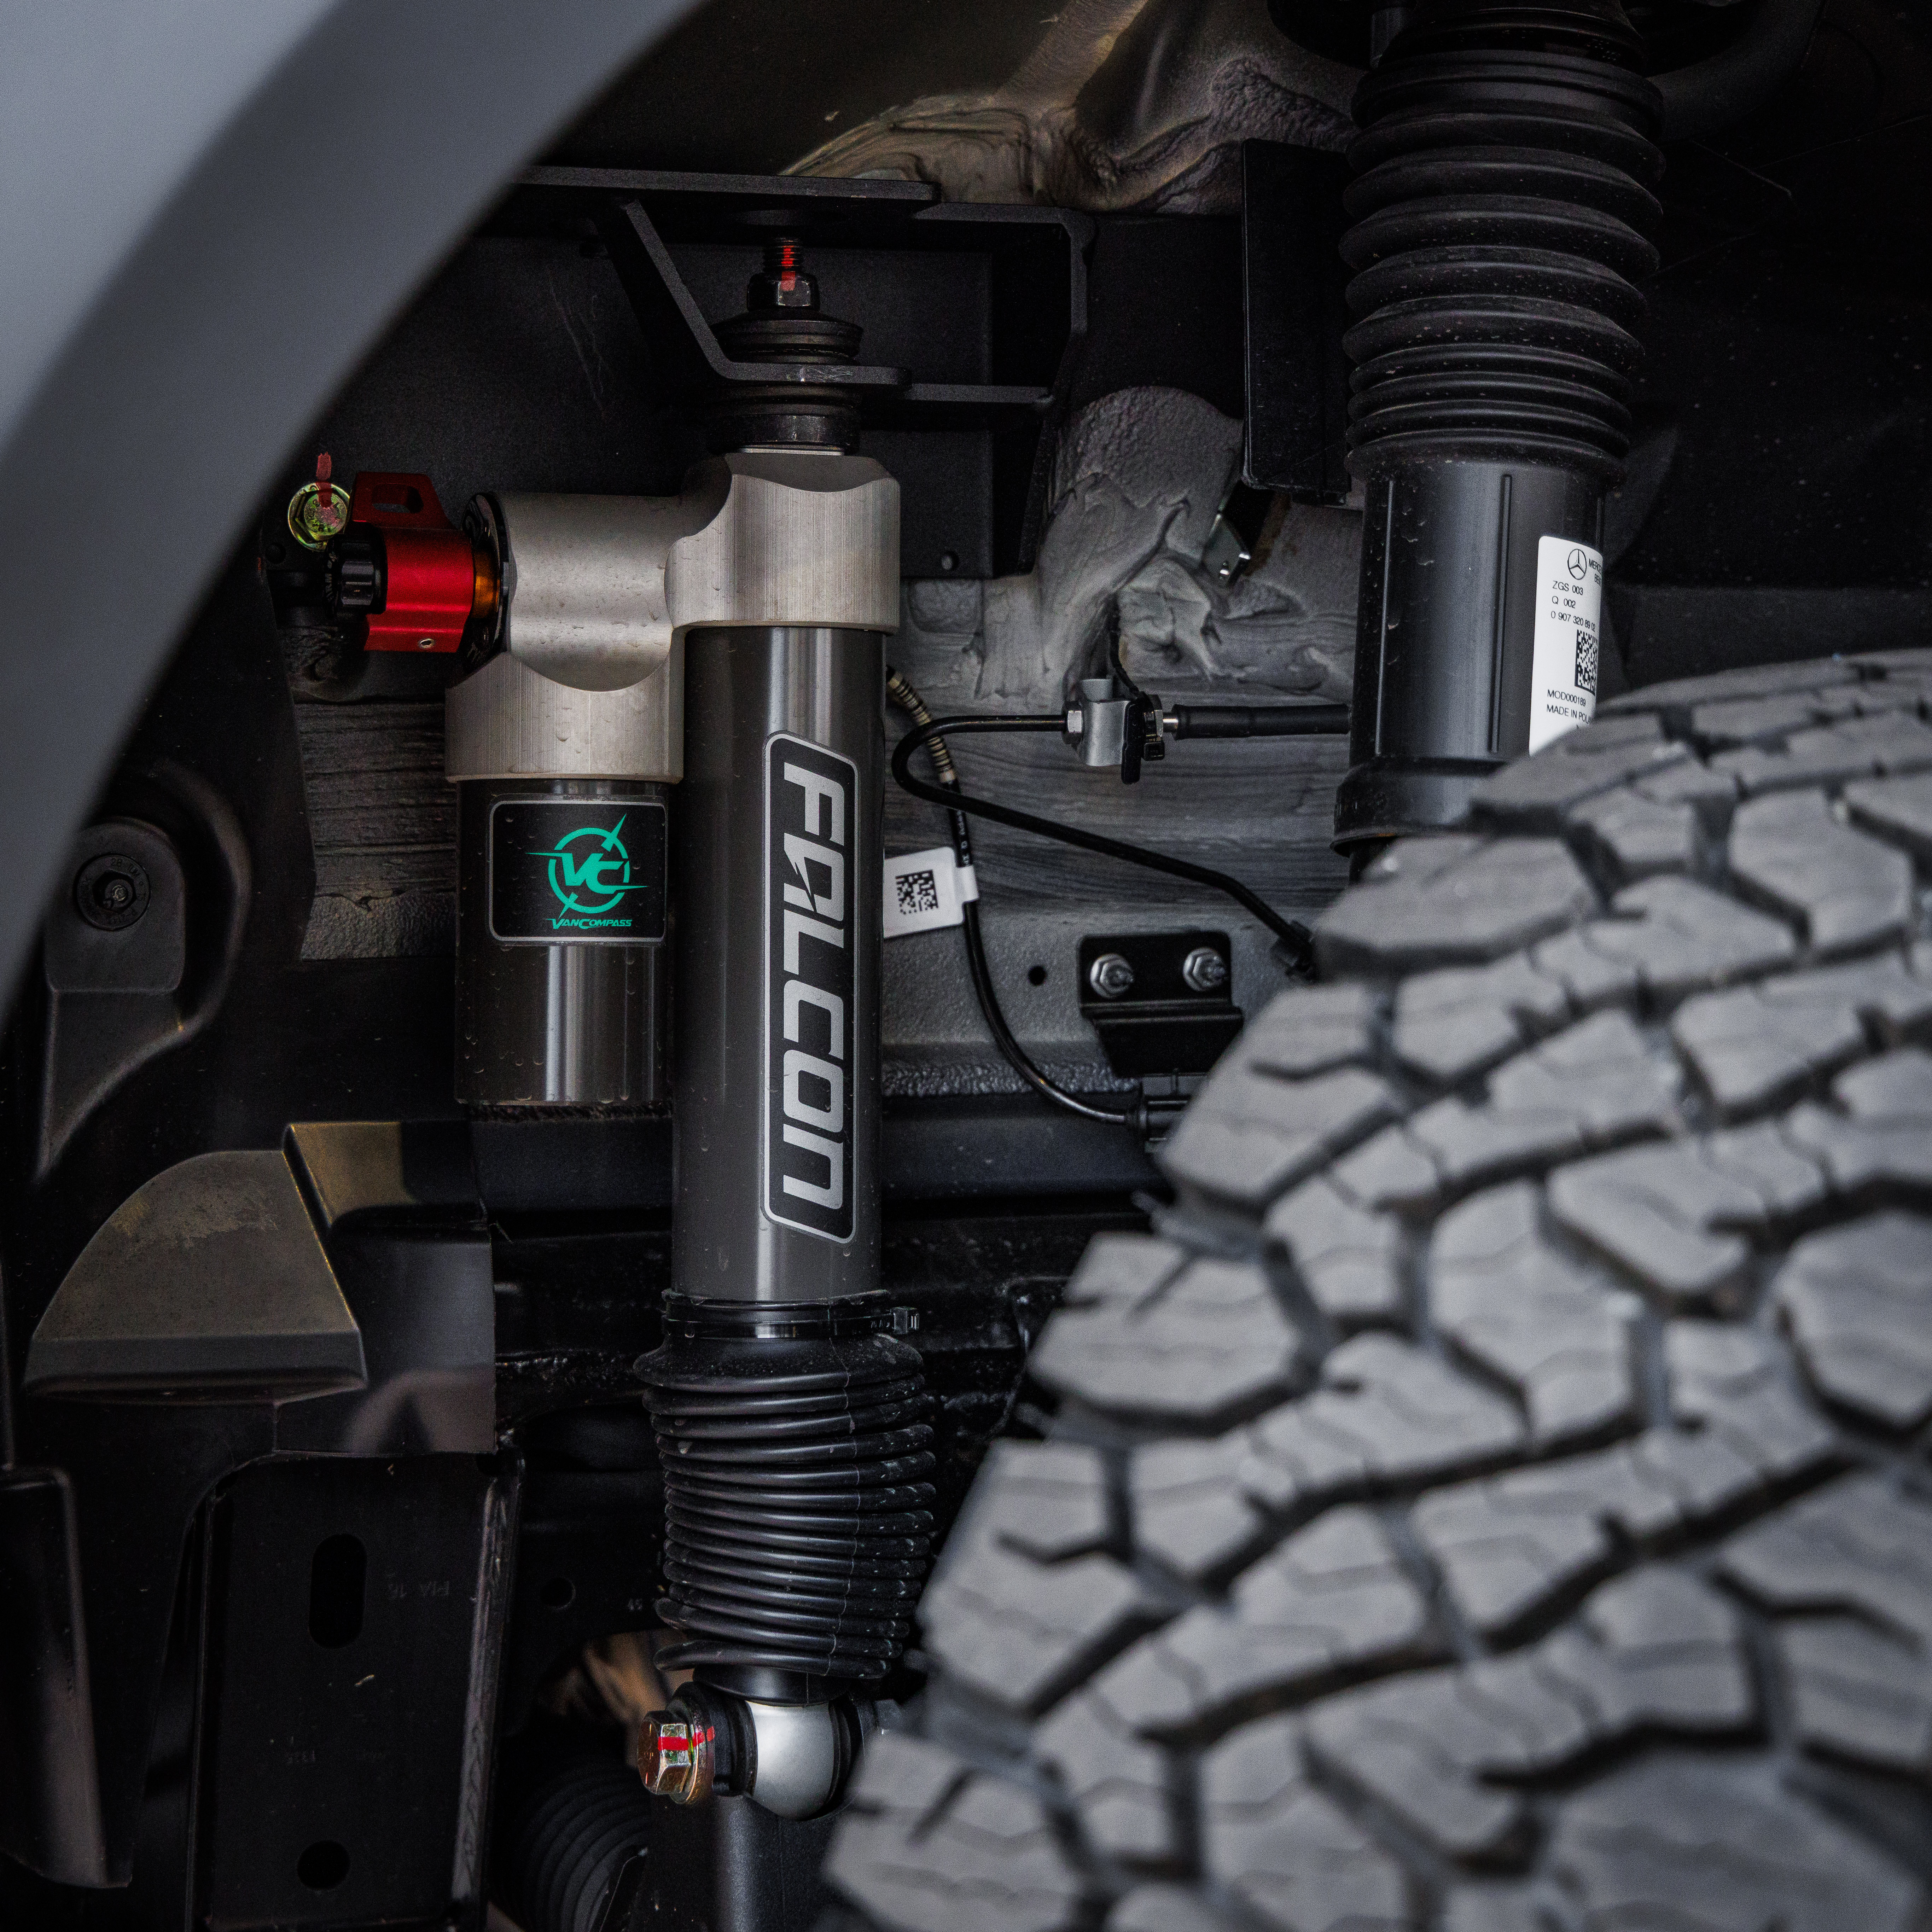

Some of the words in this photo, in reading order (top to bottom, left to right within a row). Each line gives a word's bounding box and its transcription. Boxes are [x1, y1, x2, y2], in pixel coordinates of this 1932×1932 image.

[1589, 558, 1602, 575] MERCE
[1552, 581, 1569, 592] ZGS
[1572, 585, 1583, 595] 003
[1552, 596, 1559, 605] Q
[1564, 598, 1576, 609] 002
[1558, 612, 1571, 622] 907
[1573, 616, 1583, 626] 320
[1585, 619, 1590, 629] 89
[1591, 623, 1595, 632] 02
[1547, 689, 1586, 706] MOD000189
[1547, 704, 1569, 717] MADE
[1571, 709, 1577, 719] IN
[784, 762, 844, 1210] FALCON
